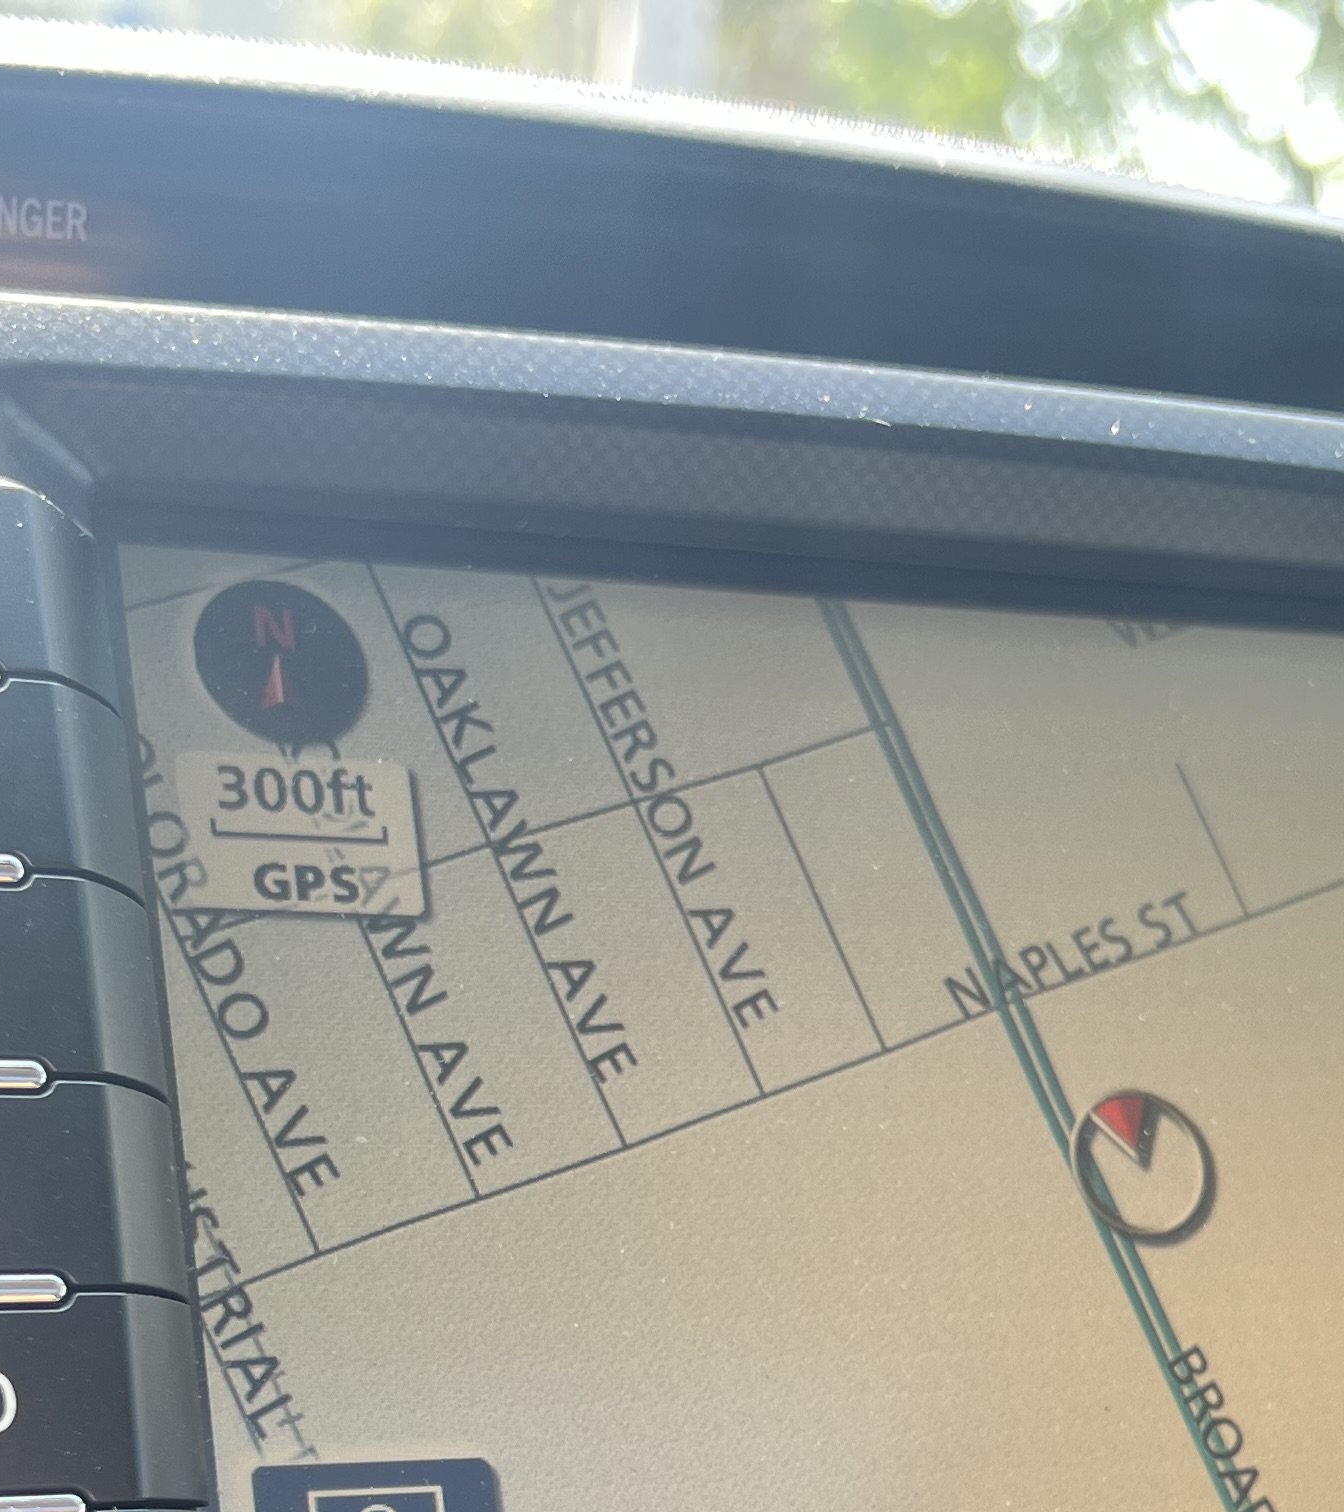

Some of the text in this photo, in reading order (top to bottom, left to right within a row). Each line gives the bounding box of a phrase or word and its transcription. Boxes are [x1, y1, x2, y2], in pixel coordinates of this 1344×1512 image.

[217, 764, 376, 817] 300ft
[403, 614, 639, 1085] OAKLAWN AVE
[546, 582, 779, 1030] JEFFERSON AVE
[254, 862, 360, 903] GPS
[943, 888, 1205, 1023] NAPLES ST
[241, 1067, 342, 1199] AVE
[419, 1039, 514, 1168] AVE
